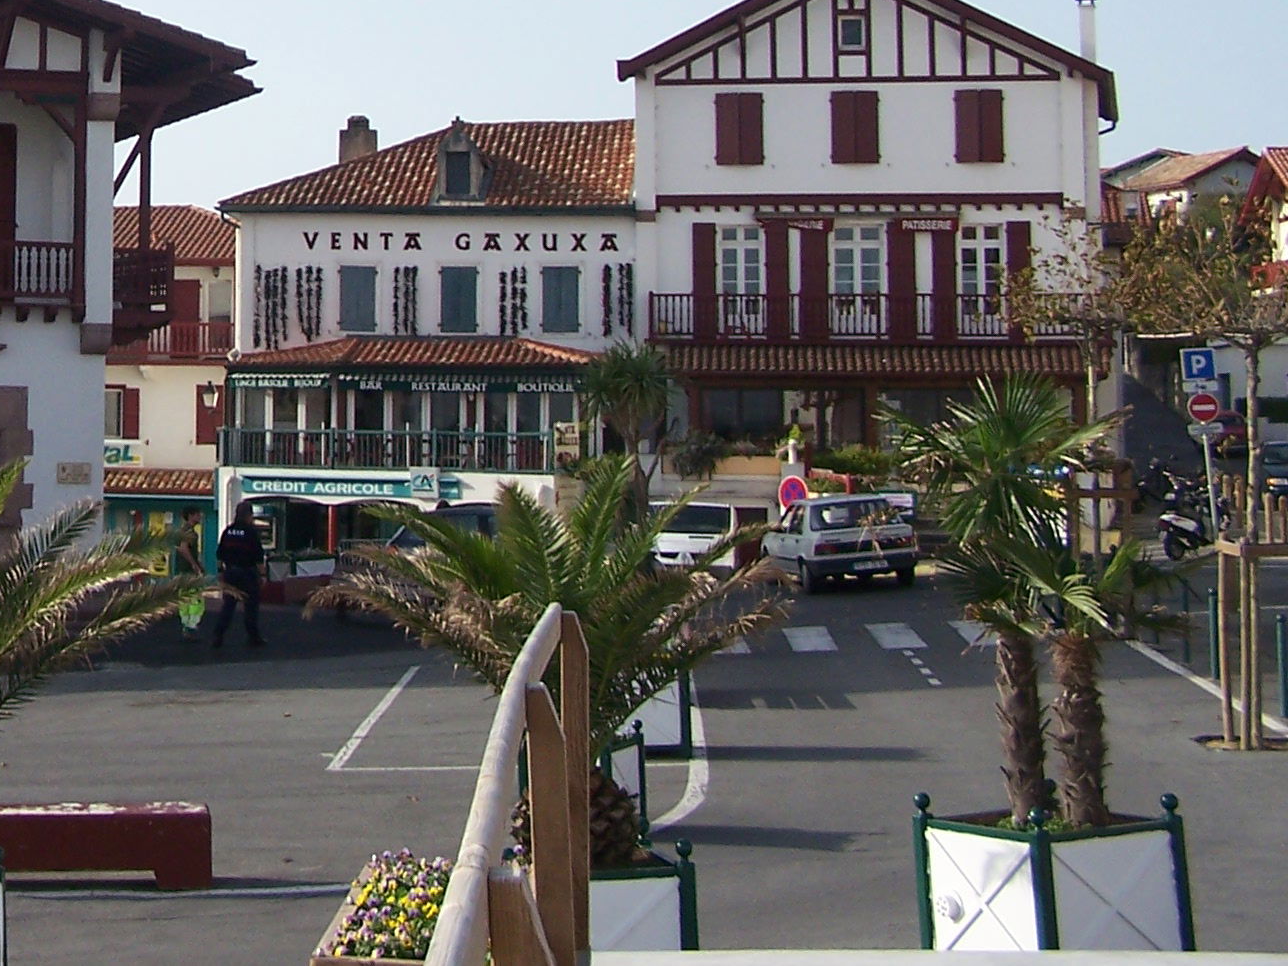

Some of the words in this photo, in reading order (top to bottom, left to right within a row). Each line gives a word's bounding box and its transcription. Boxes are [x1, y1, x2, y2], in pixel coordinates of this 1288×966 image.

[902, 220, 952, 230] PATISSERIE
[303, 232, 422, 251] VENTA
[455, 232, 619, 252] GAXUXA
[1190, 354, 1207, 375] P
[359, 380, 382, 390] BAR
[411, 381, 487, 392] RESTAURANT
[517, 383, 574, 392] BOUTIQUE
[313, 482, 394, 494] AGRICOLE
